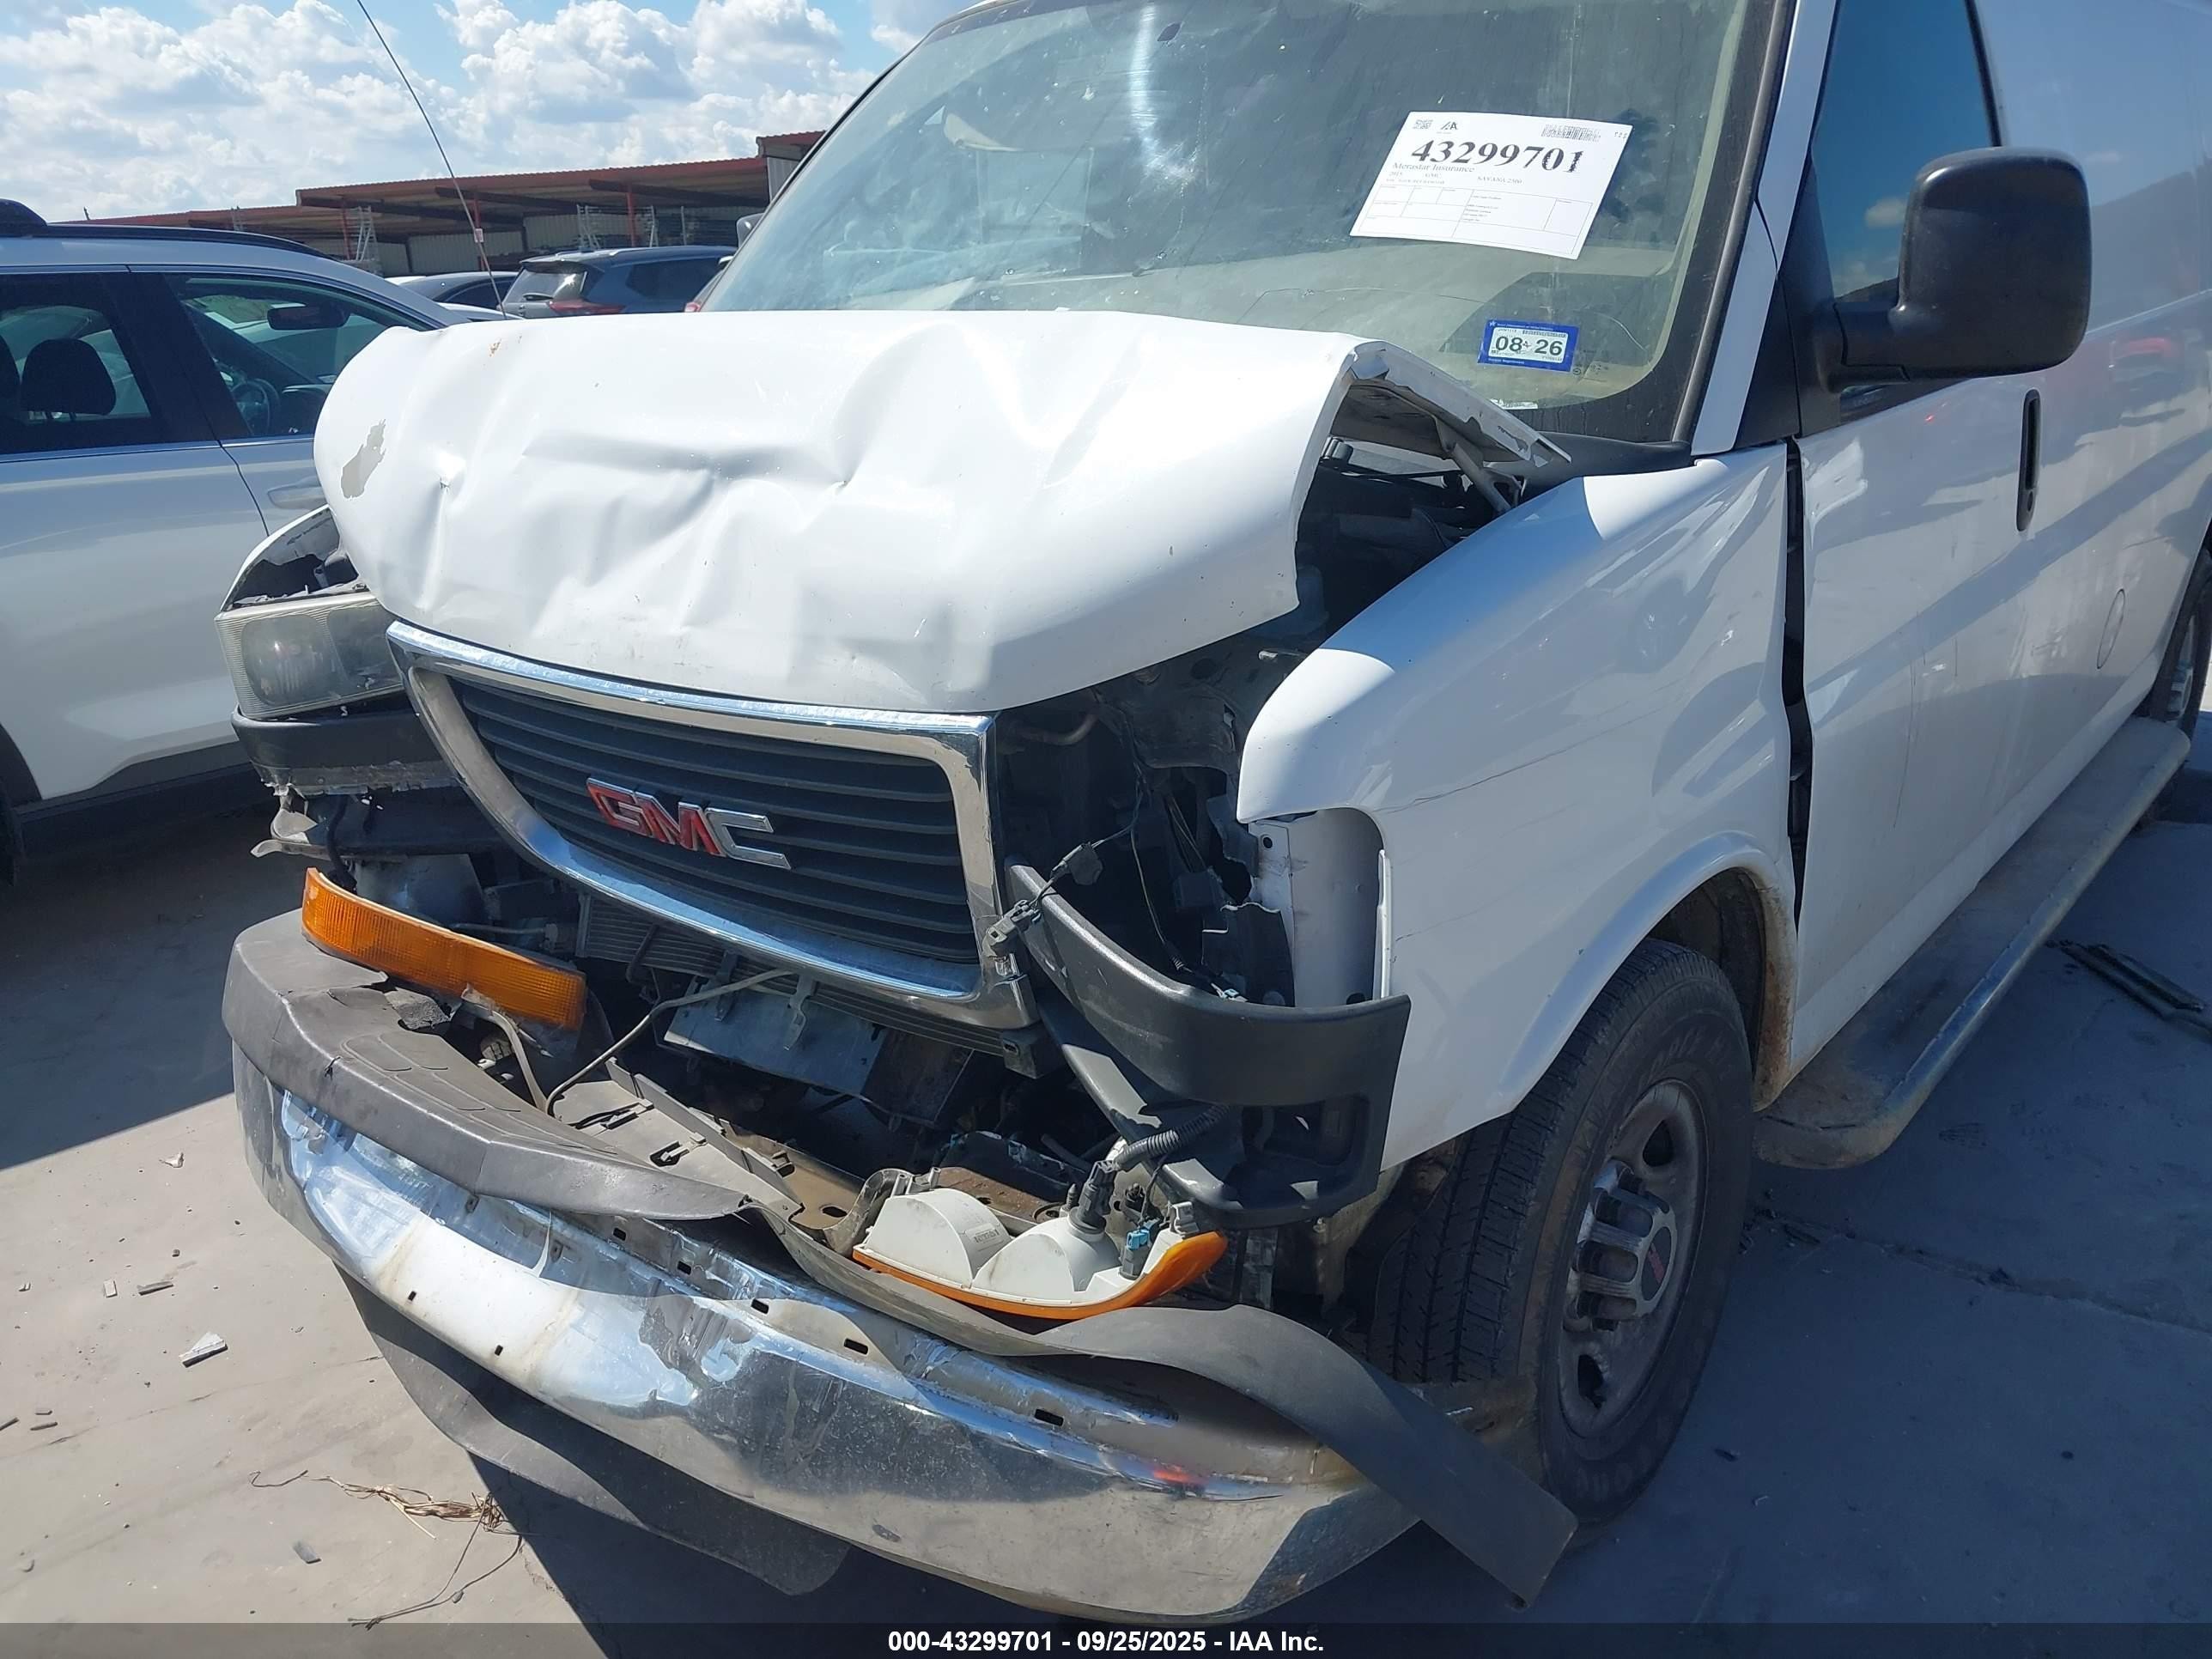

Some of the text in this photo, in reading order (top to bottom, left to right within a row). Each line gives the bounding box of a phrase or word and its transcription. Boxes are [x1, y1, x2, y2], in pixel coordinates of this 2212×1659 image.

[1393, 162, 1475, 173] Merastar Insurance
[1411, 140, 1584, 173] 43299701
[1495, 336, 1523, 352] 08
[1534, 339, 1563, 356] 26
[586, 777, 792, 870] GMC
